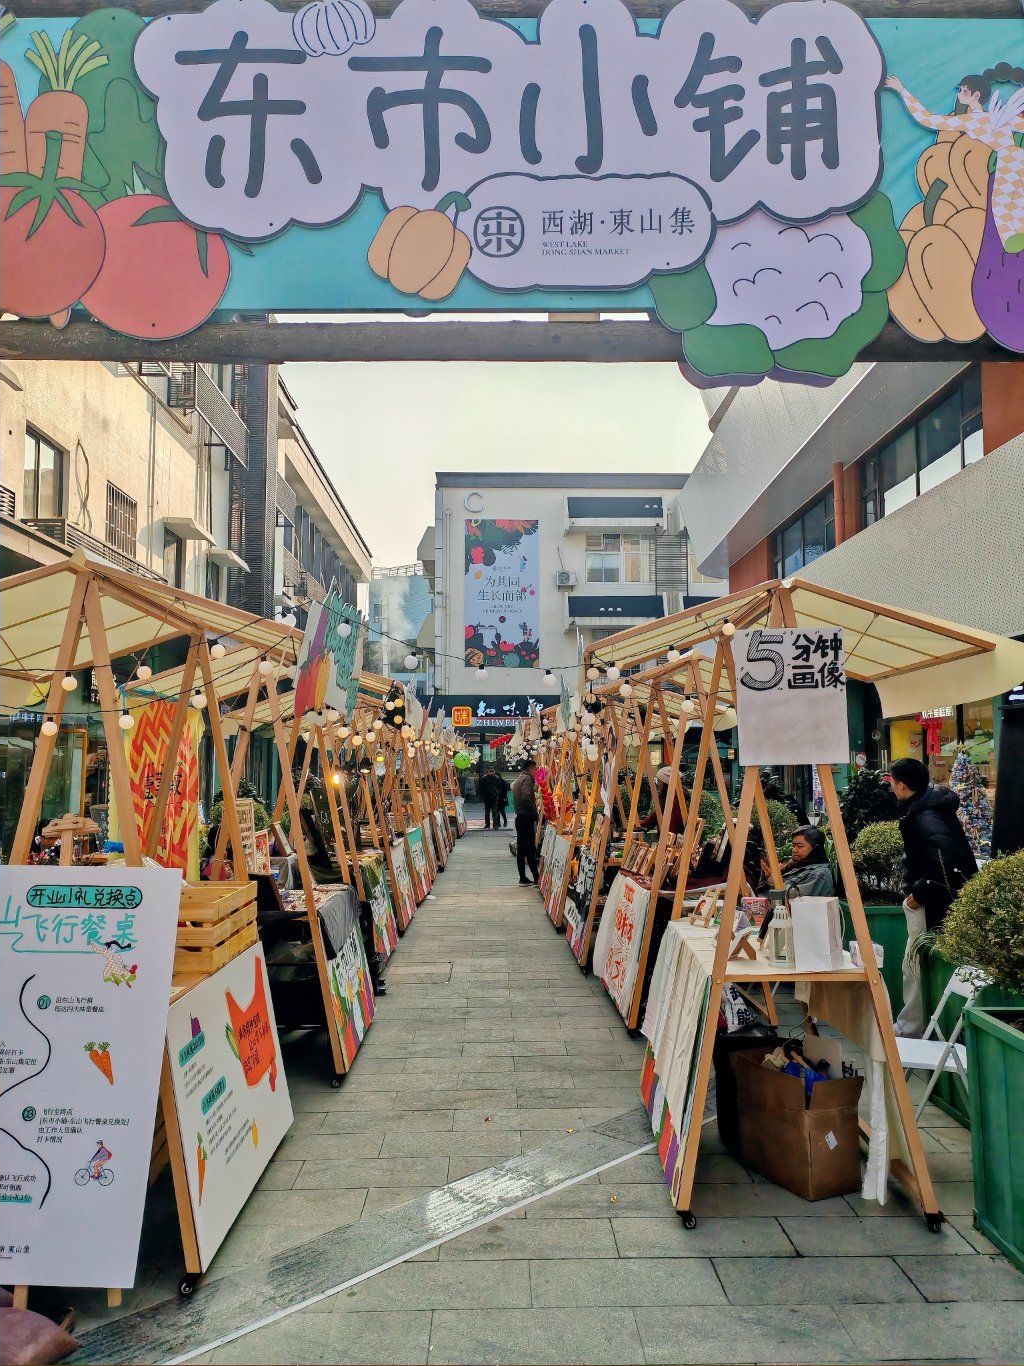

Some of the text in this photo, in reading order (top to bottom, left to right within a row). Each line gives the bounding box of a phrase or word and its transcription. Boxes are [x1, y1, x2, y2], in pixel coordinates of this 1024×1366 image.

[175, 24, 844, 199] 东市小铺
[541, 240, 589, 249] WEST LAKE
[541, 248, 630, 256] DONG SHAN MARKET
[741, 630, 843, 692] 5 分钟
[787, 663, 846, 691] 画像
